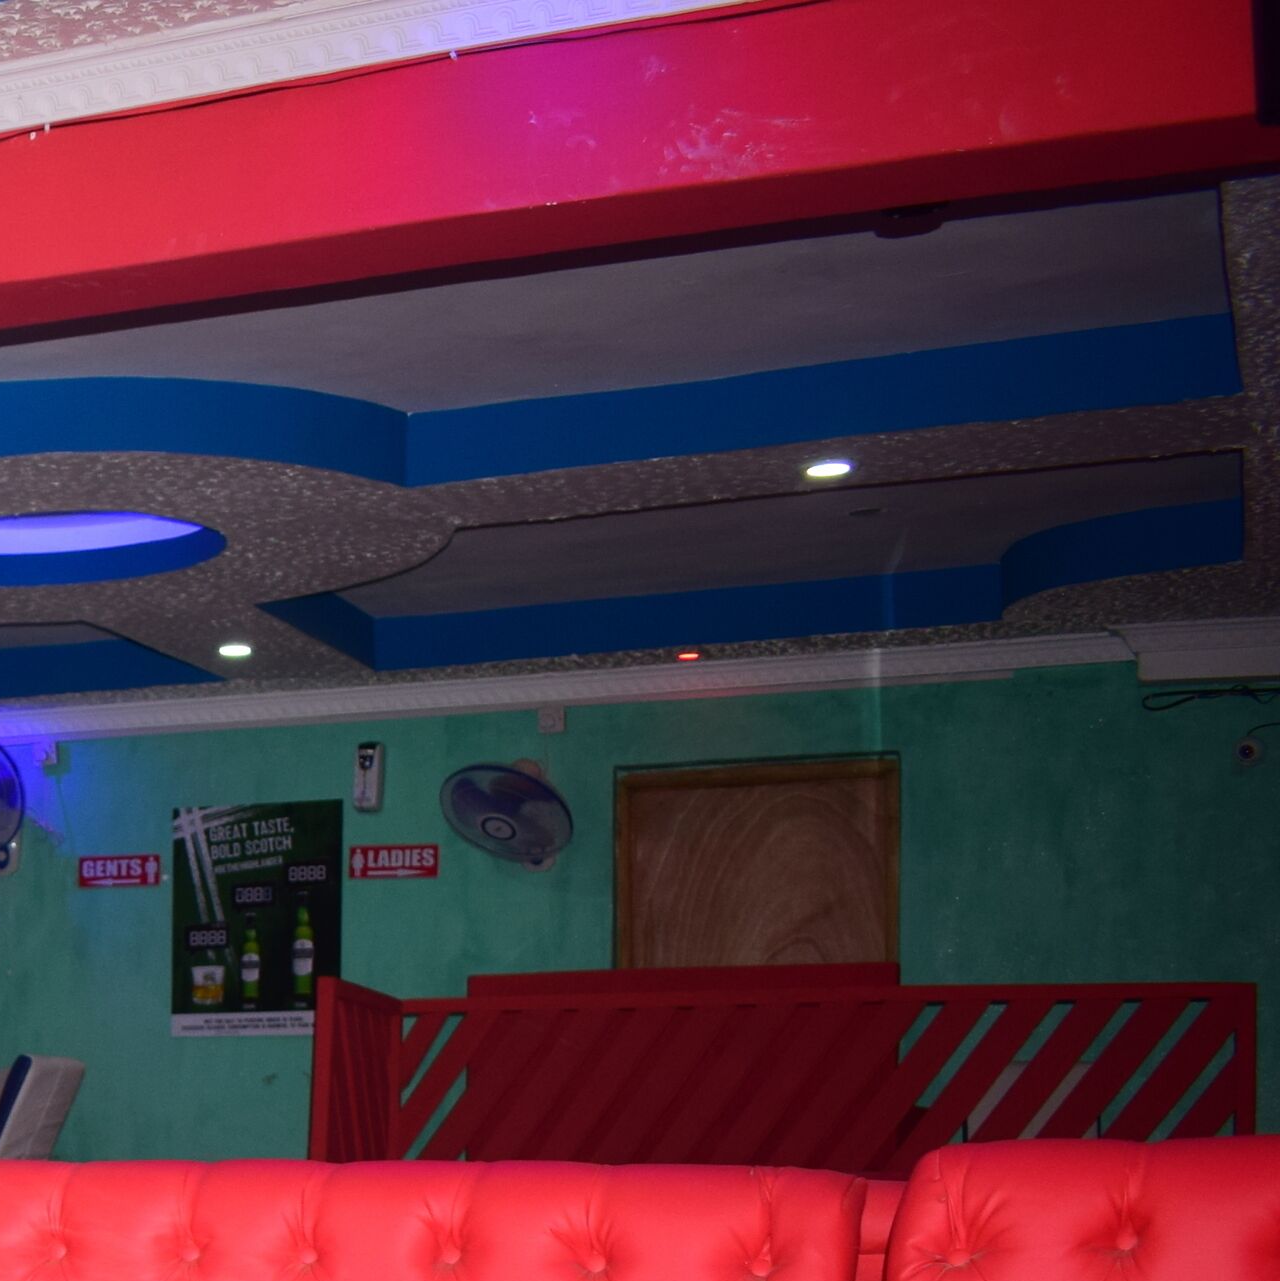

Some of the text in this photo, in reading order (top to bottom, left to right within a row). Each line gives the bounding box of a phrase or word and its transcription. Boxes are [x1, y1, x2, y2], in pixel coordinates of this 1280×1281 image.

[208, 823, 248, 842] GREAT
[210, 834, 293, 861] BOLD SCOTCH
[366, 847, 436, 868] LADIES
[82, 857, 142, 879] GENTS
